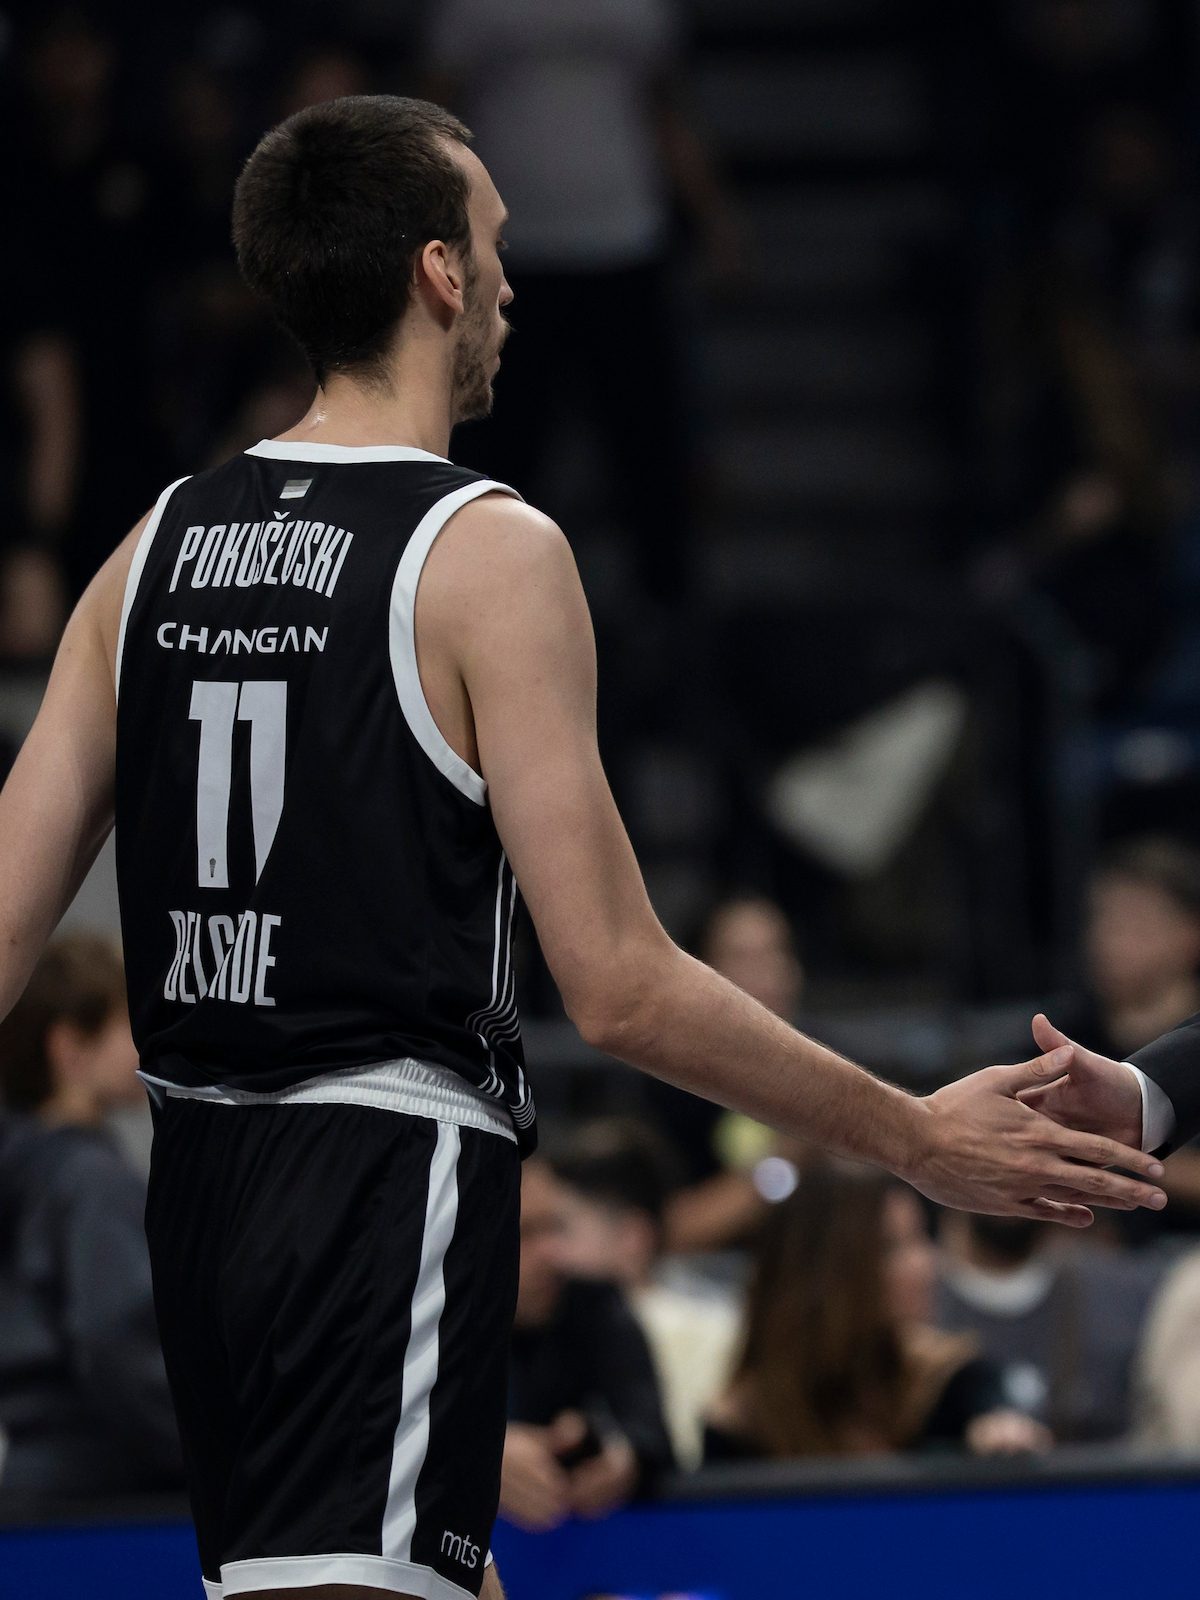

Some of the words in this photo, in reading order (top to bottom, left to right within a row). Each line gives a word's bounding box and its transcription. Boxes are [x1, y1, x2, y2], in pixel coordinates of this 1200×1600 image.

[169, 511, 354, 598] POKUŠEVSKI
[156, 622, 328, 655] CHANGAN
[188, 681, 287, 888] 11
[440, 1529, 481, 1569] mts
